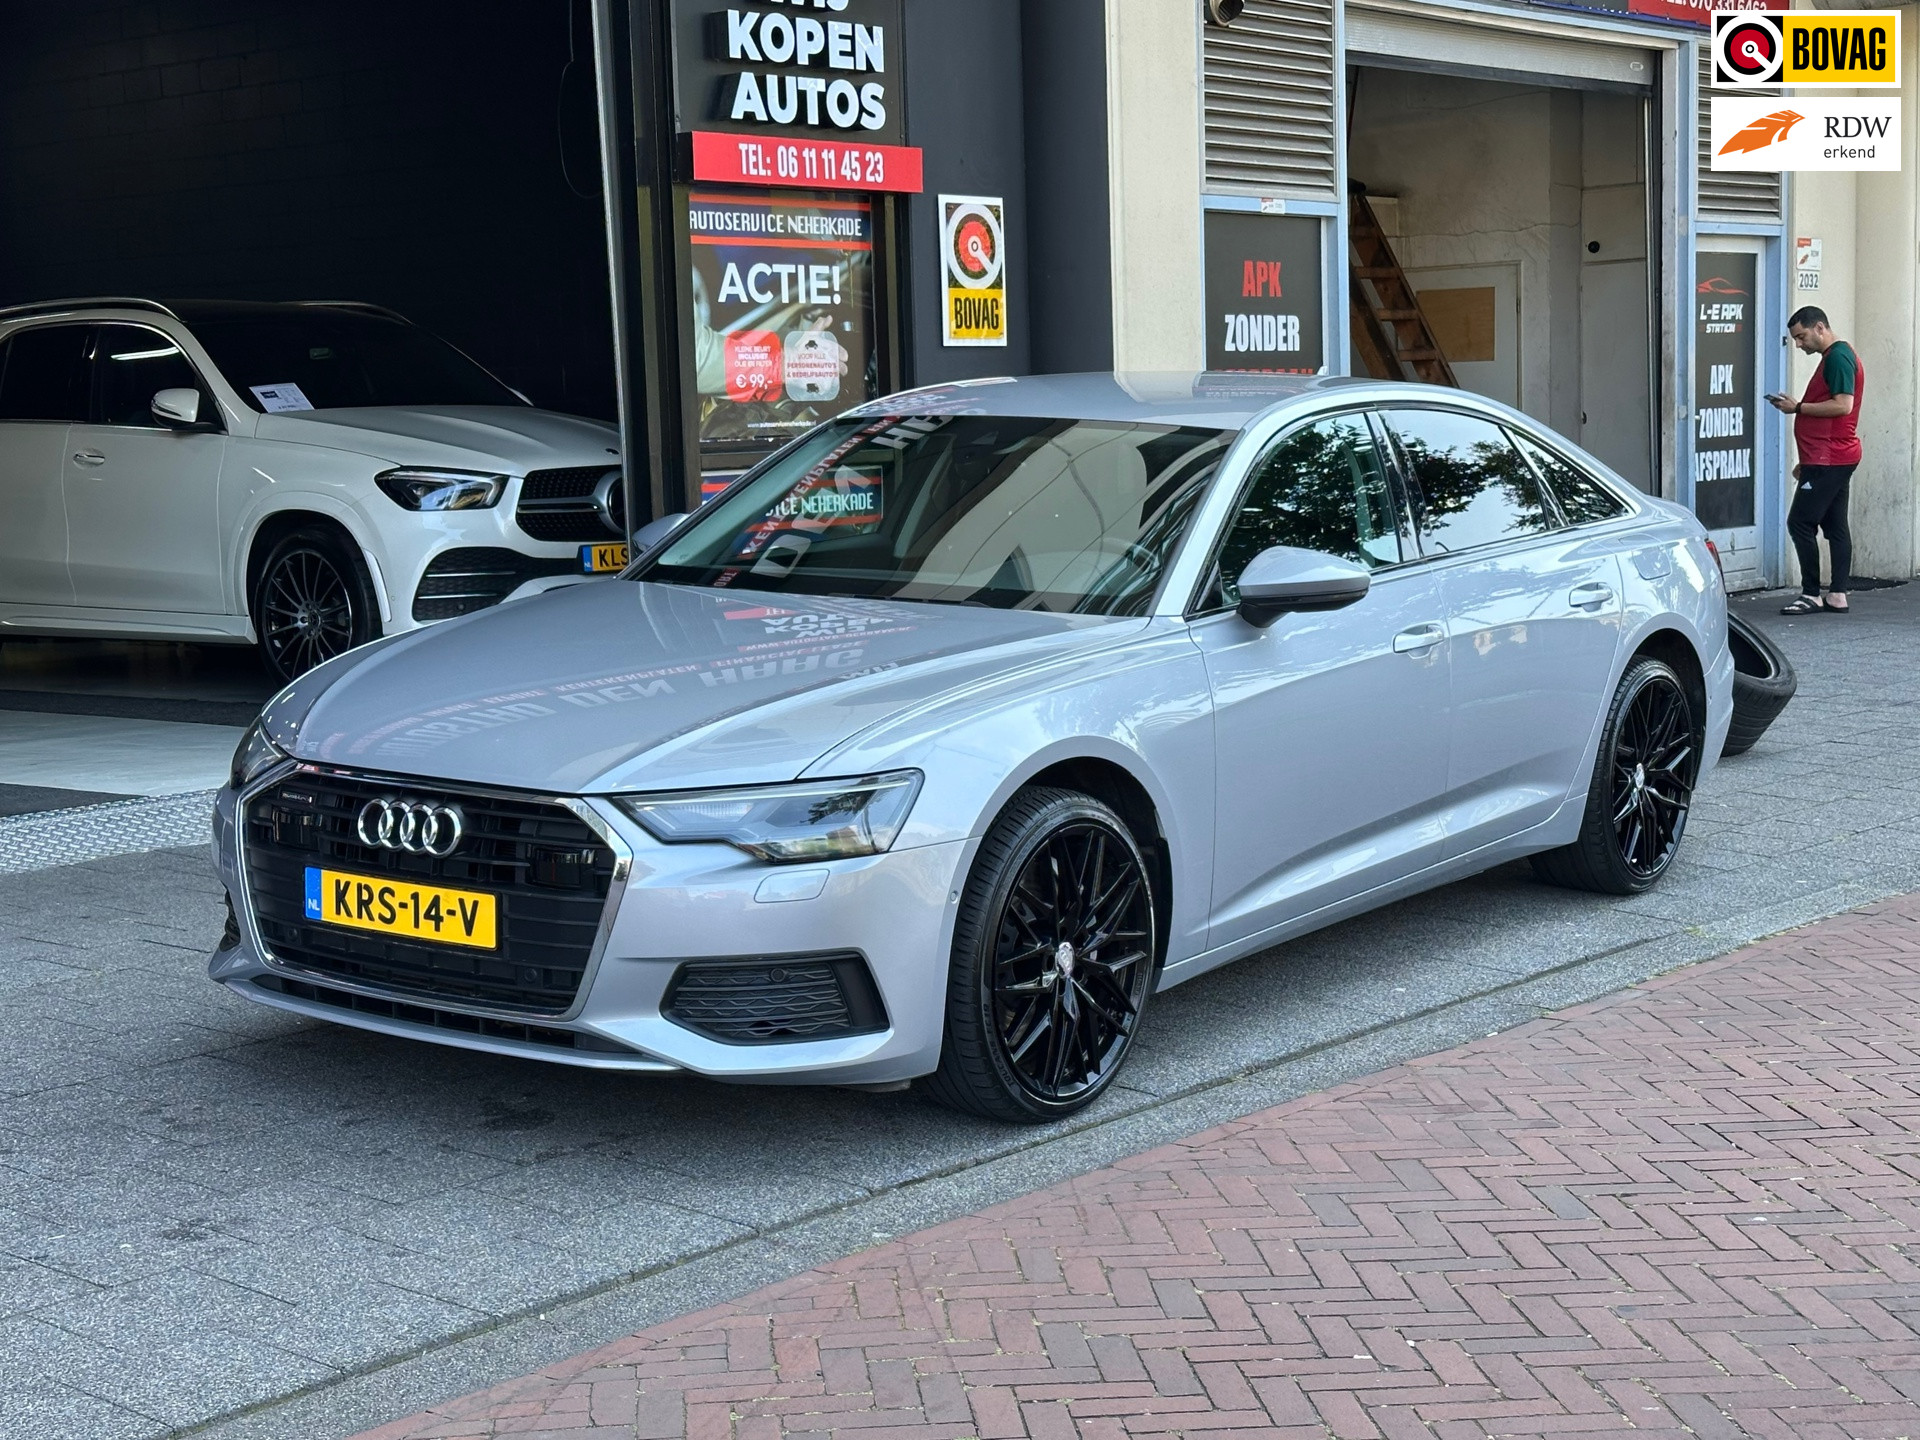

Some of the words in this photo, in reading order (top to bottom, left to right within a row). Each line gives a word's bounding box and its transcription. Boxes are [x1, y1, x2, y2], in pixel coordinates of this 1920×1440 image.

[727, 9, 885, 73] KOPEN
[730, 71, 887, 131] AUTOS
[738, 143, 772, 176] TEL:
[777, 145, 798, 178] 06
[802, 147, 817, 179] 11
[821, 148, 836, 180] 11
[840, 150, 861, 182] 45
[865, 151, 884, 183] 23
[689, 210, 785, 233] AUTOSERVICE
[788, 215, 863, 237] NEHERKADE
[718, 262, 842, 305] ACTIE!
[1241, 260, 1282, 297] APK
[1799, 273, 1819, 289] 2032
[954, 297, 999, 330] BOVAG
[1705, 322, 1736, 334] STATION
[1720, 303, 1744, 320] APK
[1224, 313, 1301, 352] ZONDER
[1709, 364, 1734, 395] APK
[1699, 406, 1744, 439] ZONDER
[801, 492, 874, 515] NEHERKADE
[308, 898, 321, 911] NL
[334, 878, 480, 937] KRS-14-V
